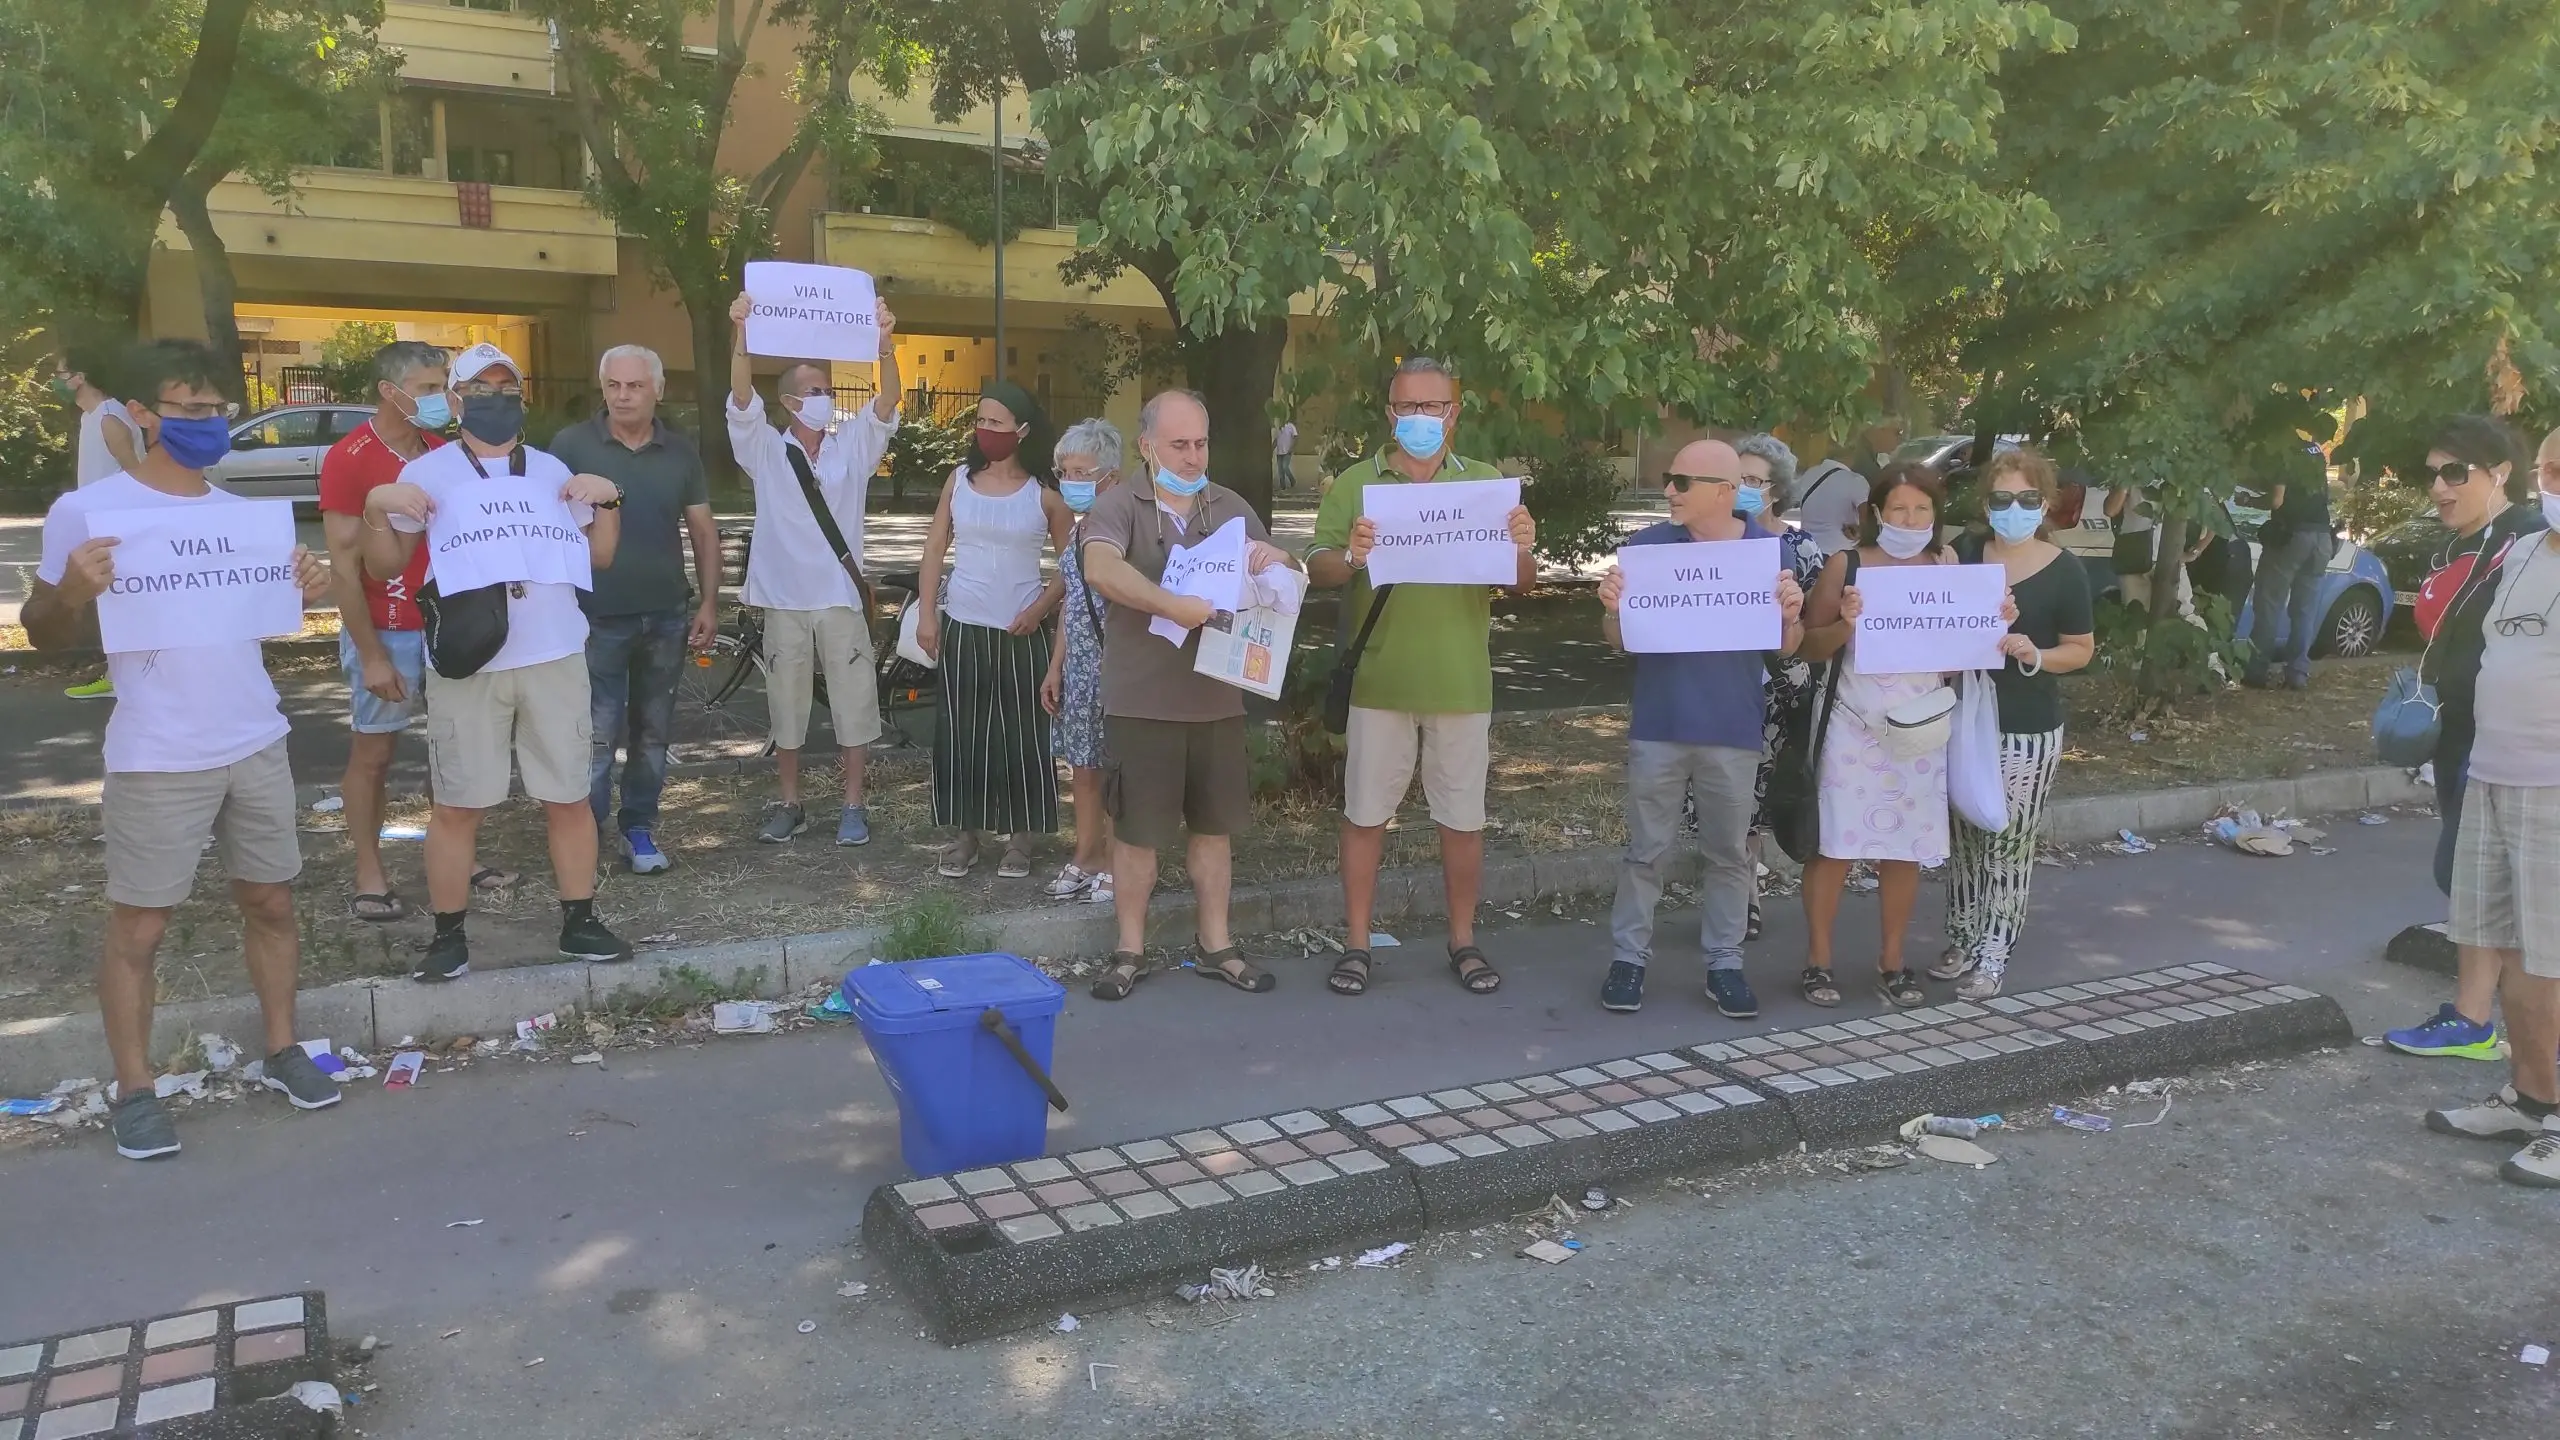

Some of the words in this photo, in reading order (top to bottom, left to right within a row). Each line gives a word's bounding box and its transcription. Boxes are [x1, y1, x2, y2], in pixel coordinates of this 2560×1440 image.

[793, 284, 820, 300] VIA
[822, 286, 835, 301] IL
[752, 303, 873, 326] COMPATTATORE
[479, 499, 515, 517] VIA
[519, 499, 536, 515] IL
[1418, 509, 1448, 524] VIA
[1452, 507, 1465, 521] IL
[2080, 518, 2110, 530] 113
[170, 537, 212, 557] VIA
[216, 535, 236, 554] IL
[439, 523, 584, 554] COMPATTATORE
[1373, 529, 1509, 547] COMPATTATORE
[109, 564, 292, 595] COMPATTATORE
[1673, 567, 1704, 582] VIA
[1709, 566, 1723, 581] IL
[1628, 591, 1773, 610] COMPATTATORE
[1908, 591, 1937, 605] VIA
[1941, 590, 1955, 604] IL
[1863, 615, 2000, 631] COMPATTATORE
